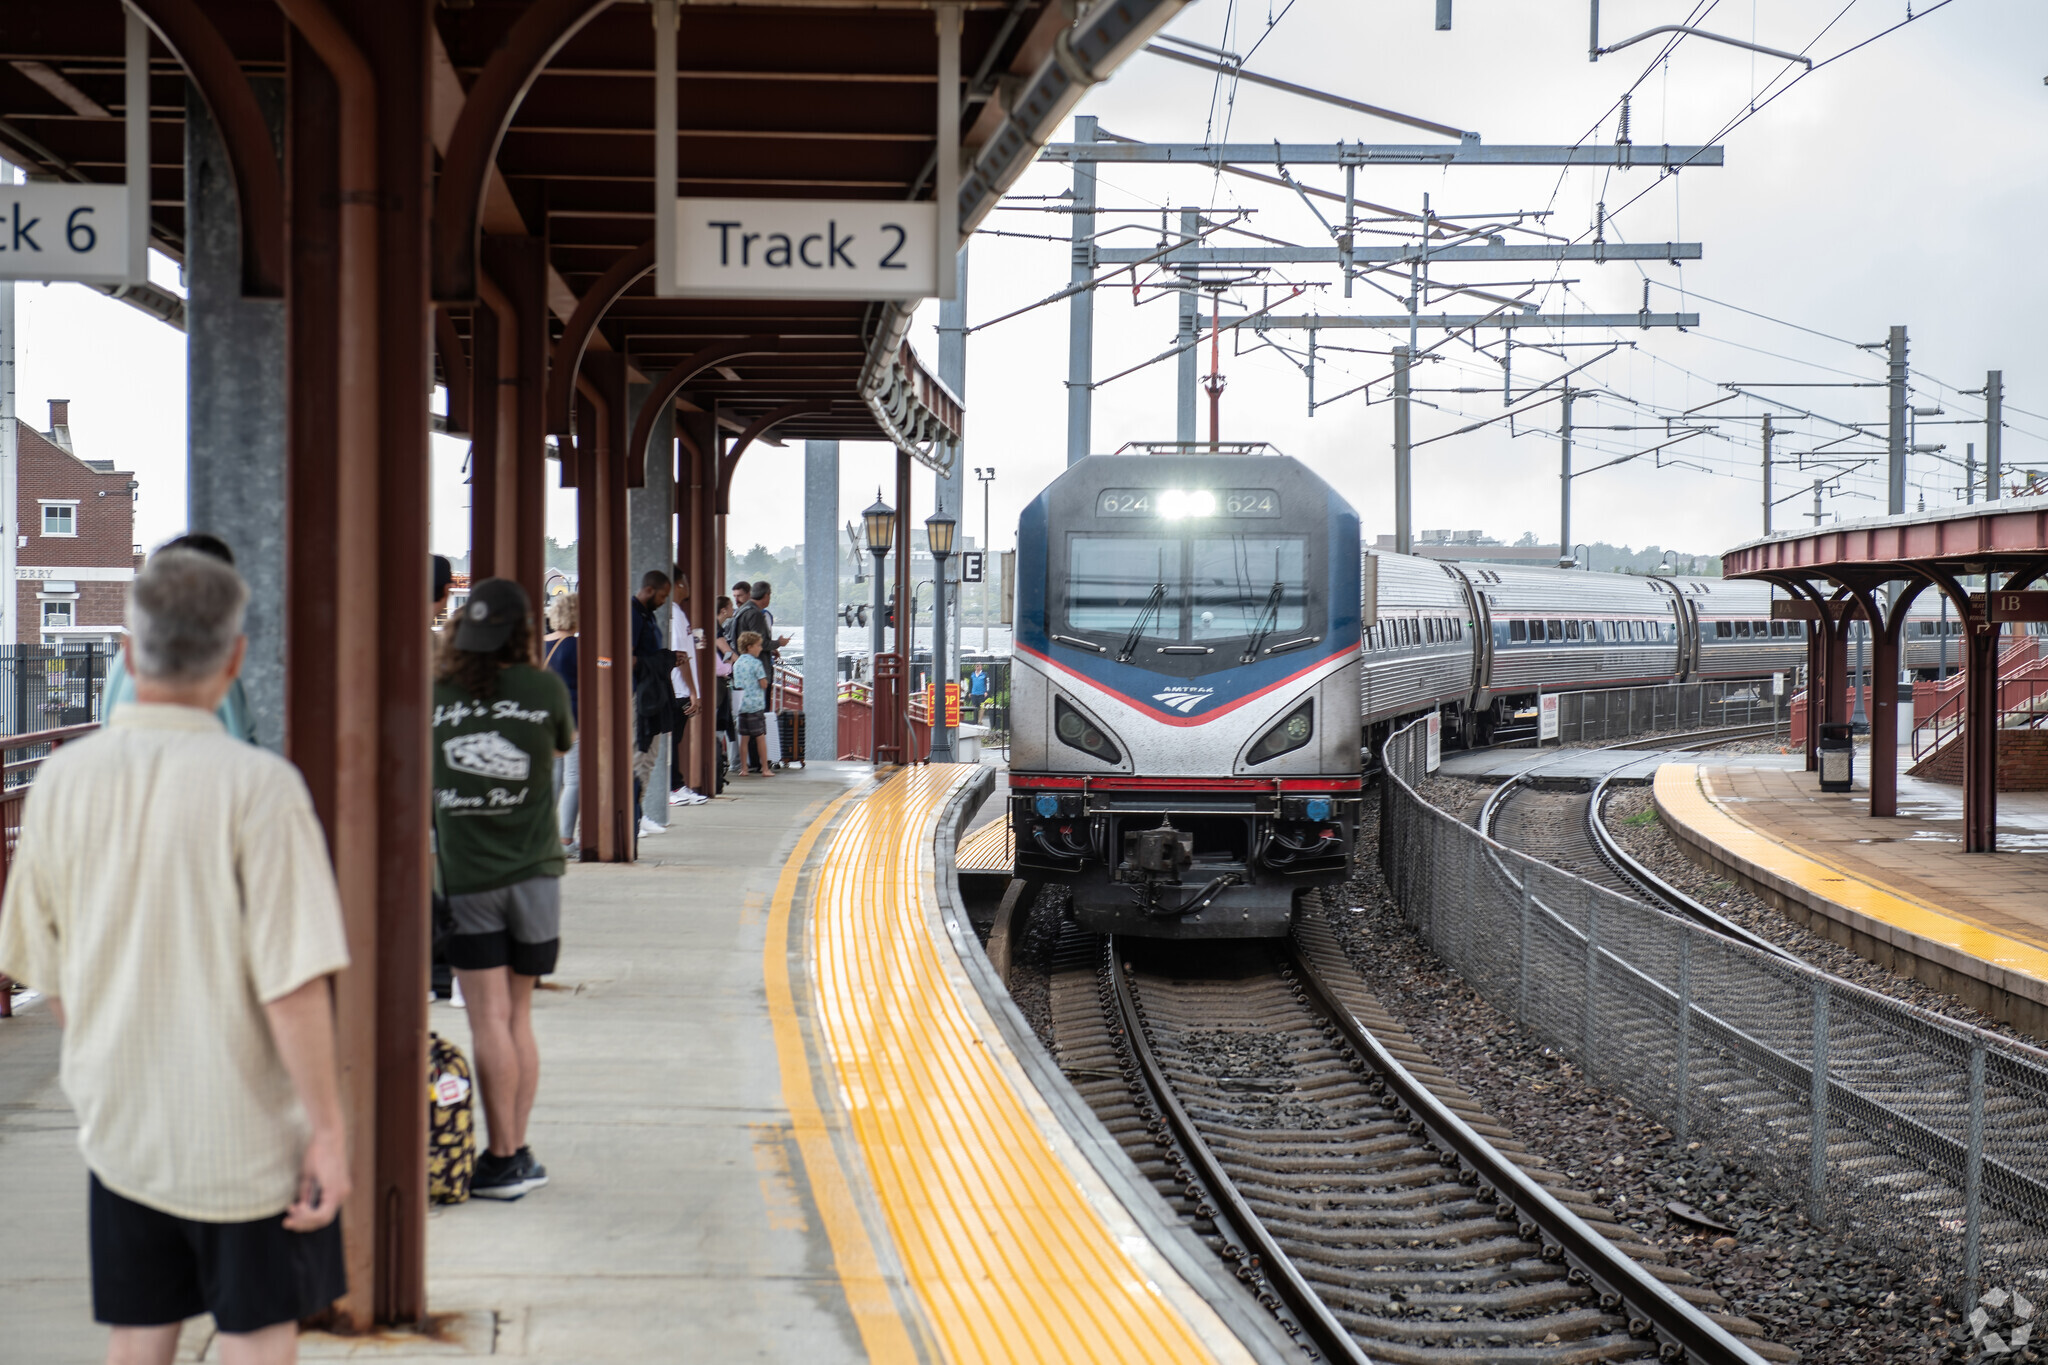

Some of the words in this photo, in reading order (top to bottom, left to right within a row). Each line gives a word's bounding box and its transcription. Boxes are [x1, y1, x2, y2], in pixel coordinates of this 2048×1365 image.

[66, 205, 97, 254] 6
[707, 219, 857, 269] Track
[878, 222, 908, 270] 2
[1103, 494, 1150, 513] 624
[1227, 495, 1273, 513] 624
[966, 555, 980, 579] E
[2000, 595, 2021, 611] 1B
[931, 695, 956, 705] SOP
[431, 699, 489, 727] Life's
